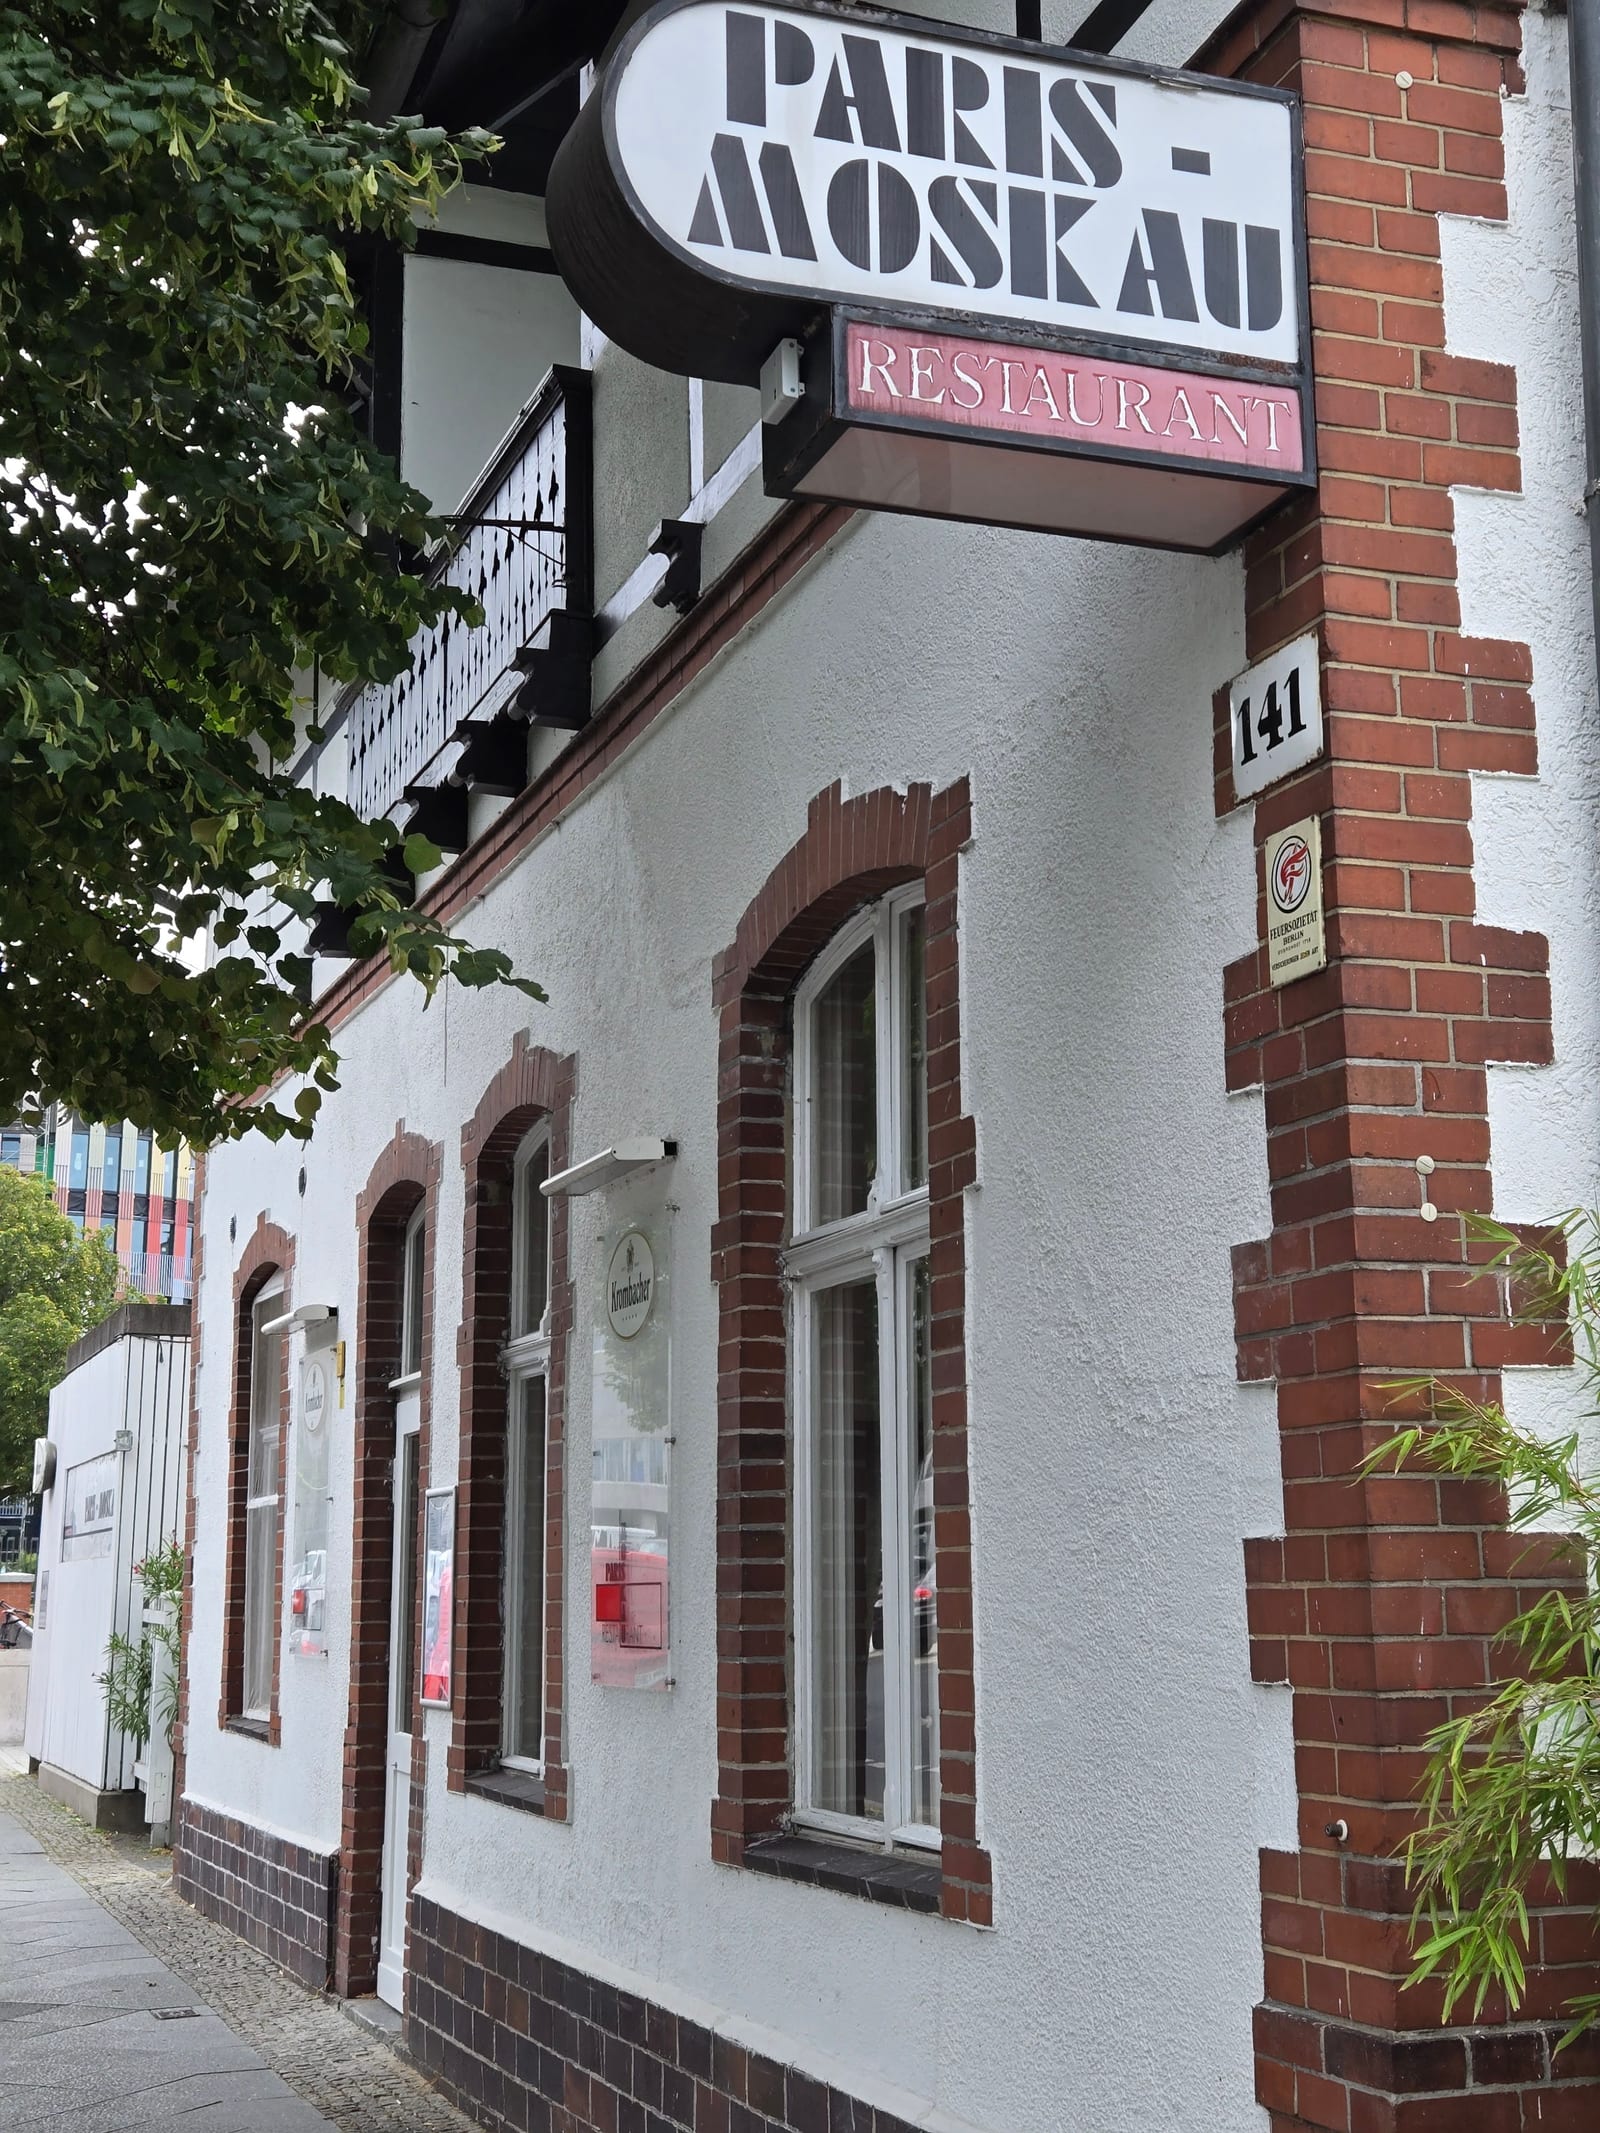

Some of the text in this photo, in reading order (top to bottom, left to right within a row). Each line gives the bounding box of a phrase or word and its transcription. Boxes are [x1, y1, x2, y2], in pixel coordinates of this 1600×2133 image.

[726, 10, 1122, 188] PARIS
[687, 133, 1283, 332] MOSKAU
[857, 338, 1292, 453] RESTAURANT
[1237, 666, 1307, 767] 141
[1283, 930, 1304, 945] BERLIN
[611, 1272, 651, 1313] Krombacher
[605, 1562, 626, 1582] PARIS
